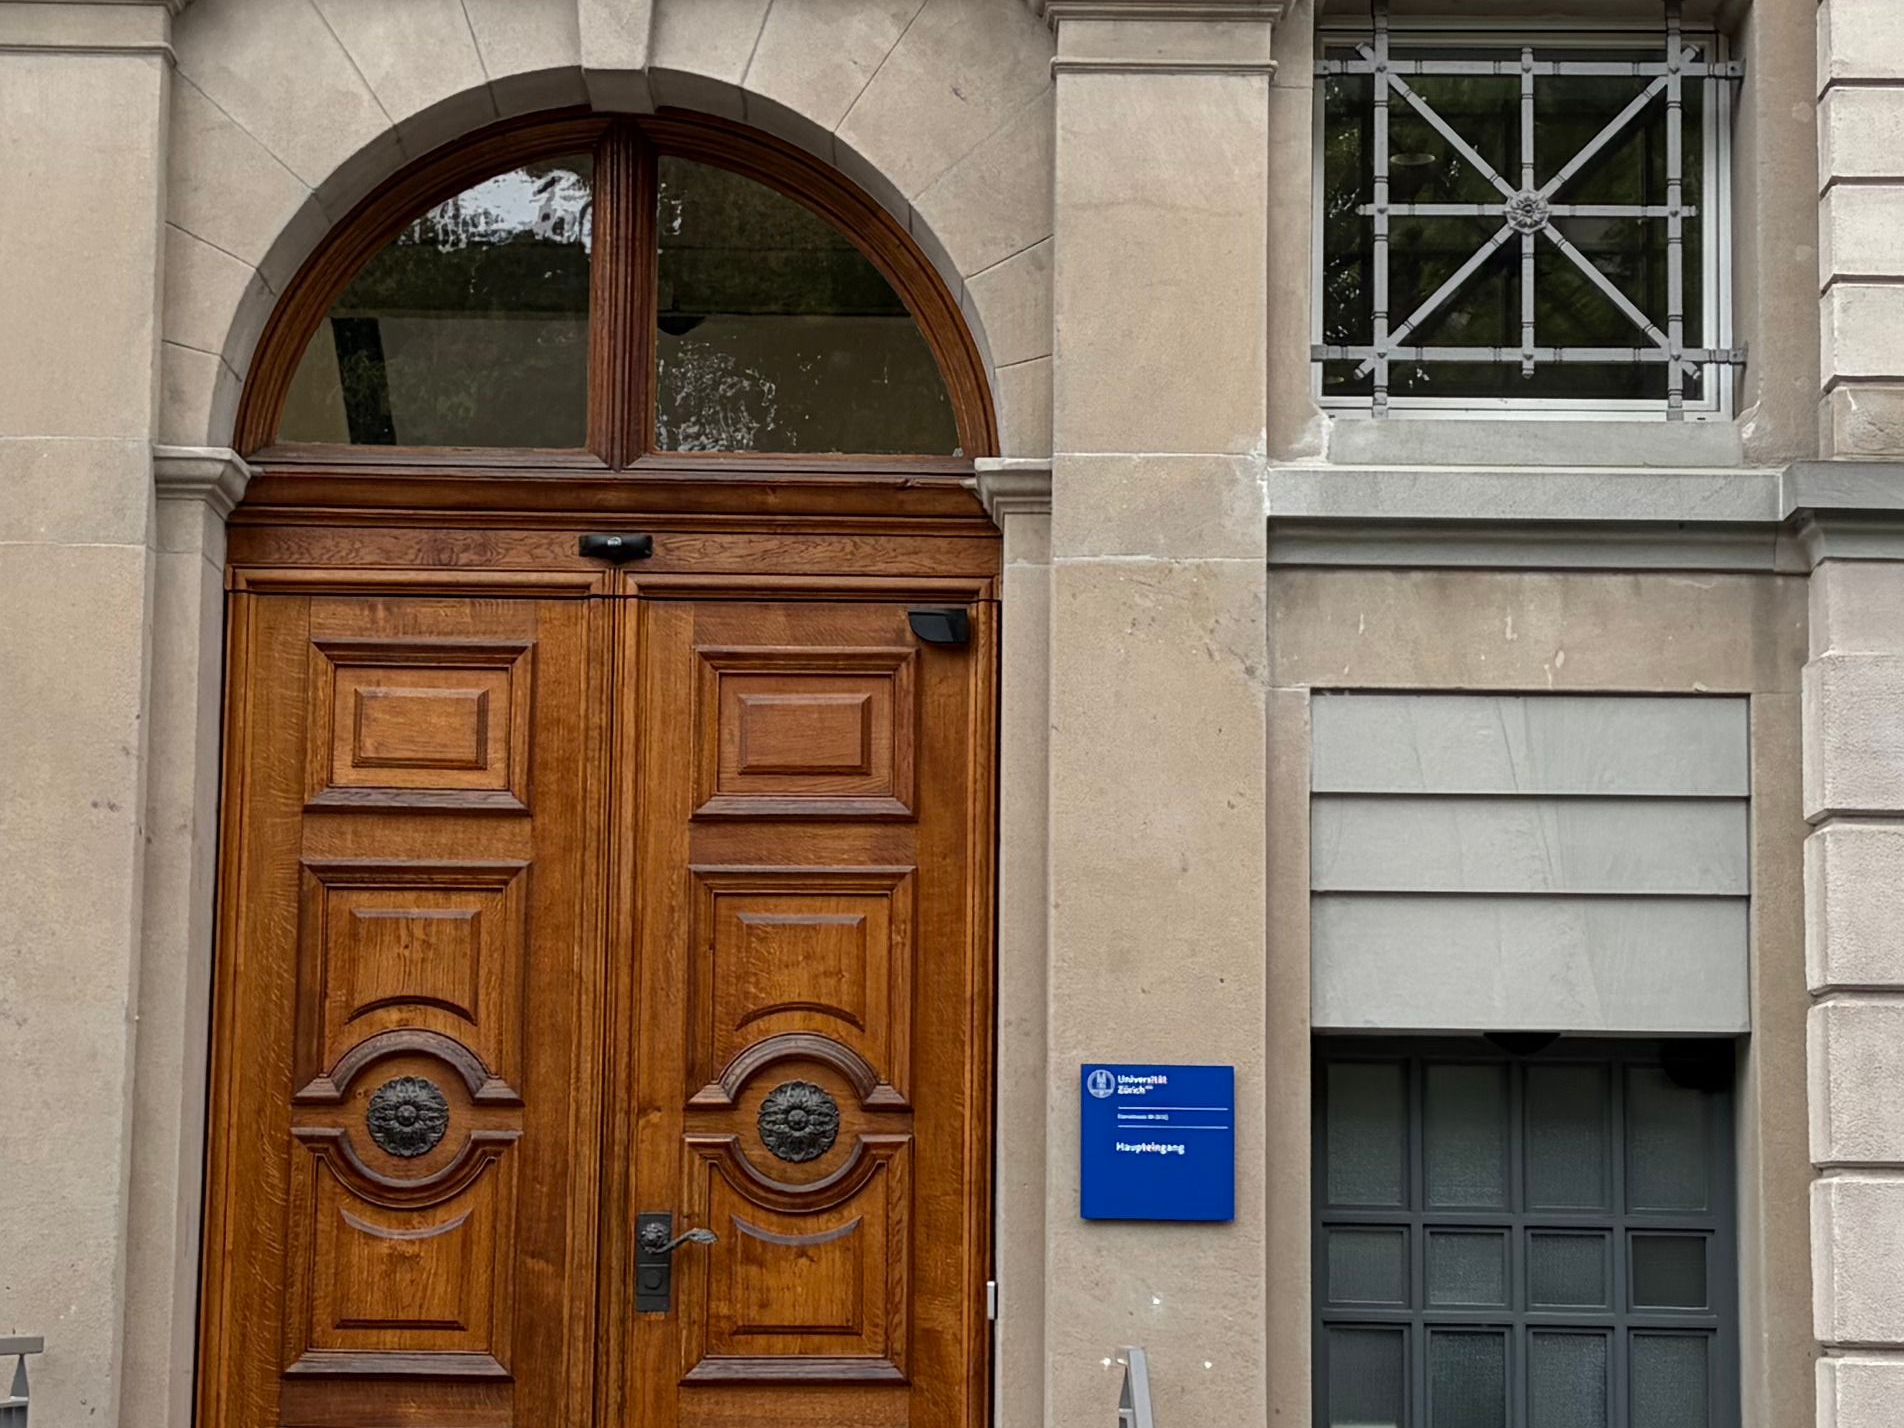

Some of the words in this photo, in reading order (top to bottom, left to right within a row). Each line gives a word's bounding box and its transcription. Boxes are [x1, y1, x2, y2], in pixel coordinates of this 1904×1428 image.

[1117, 1075, 1168, 1084] Universität
[1117, 1085, 1146, 1094] Zürich
[1116, 1141, 1185, 1155] Haupteingang
